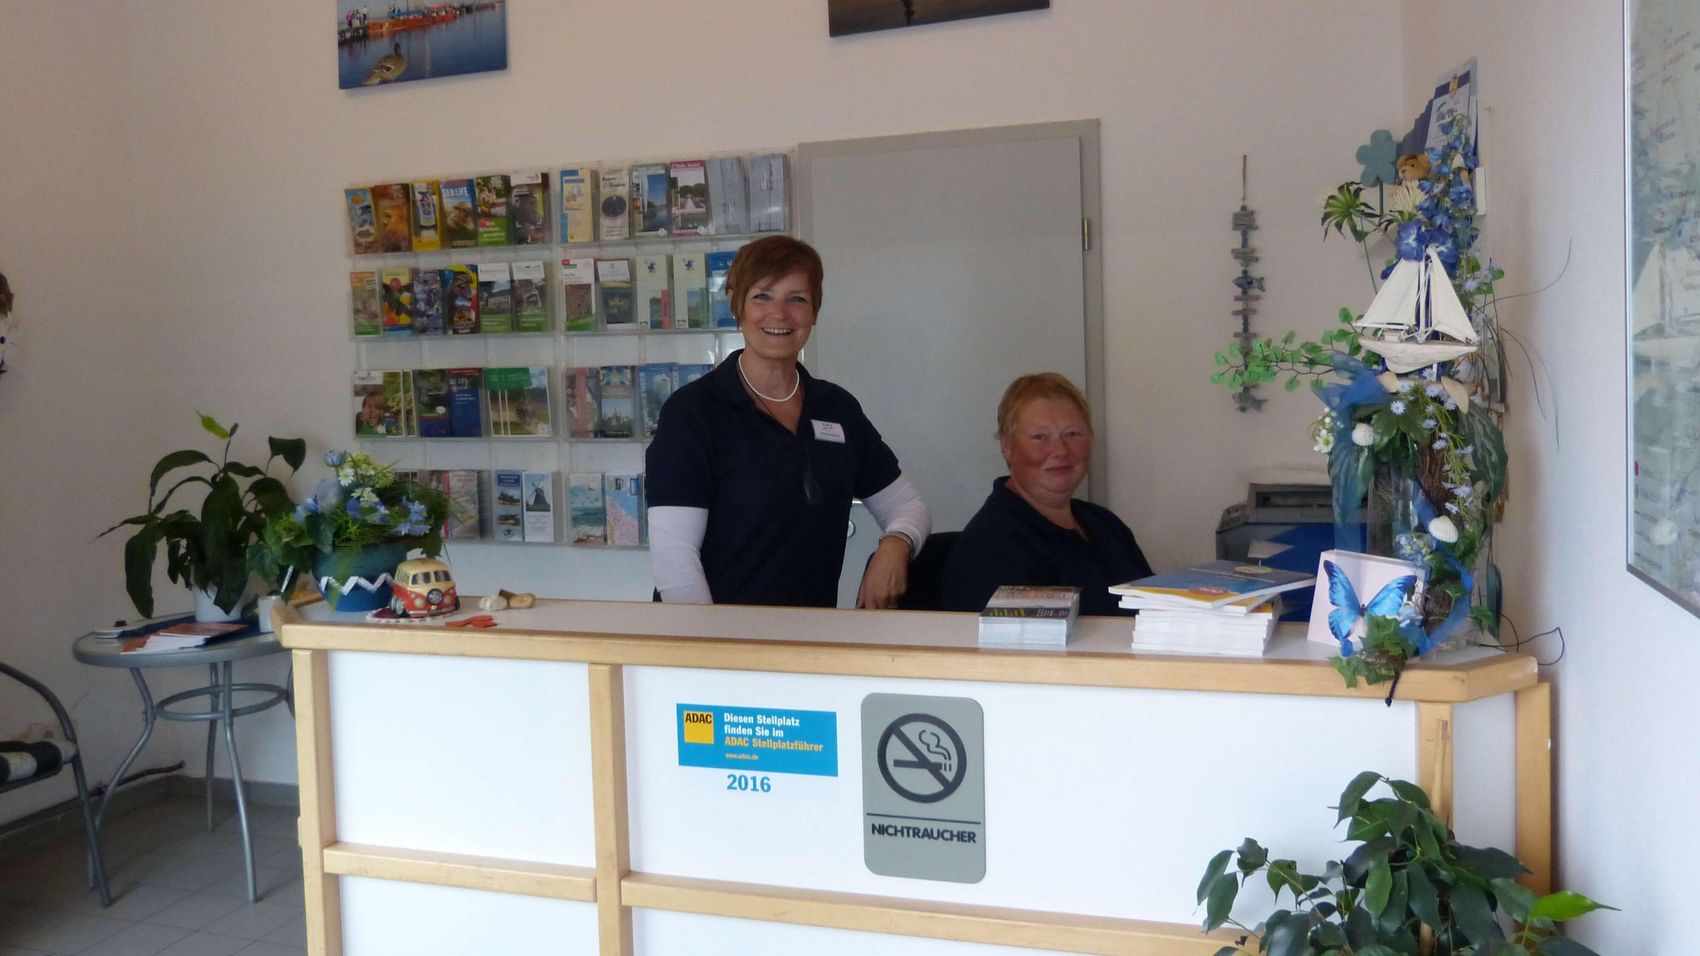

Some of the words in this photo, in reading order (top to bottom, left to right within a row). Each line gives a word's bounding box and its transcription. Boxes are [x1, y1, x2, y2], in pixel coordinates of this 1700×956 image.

[442, 188, 454, 198] SEA
[455, 186, 468, 197] LIFE
[685, 713, 712, 724] ADAC
[724, 713, 754, 724] Diesen
[757, 714, 800, 727] Stellplatz
[724, 725, 752, 735] finden
[755, 726, 770, 737] Sie
[773, 727, 784, 738] im
[724, 737, 749, 747] ADAC
[752, 738, 824, 752] Stellplatzführer
[727, 773, 771, 793] 2016
[871, 823, 977, 844] NICHTRAUCHER
